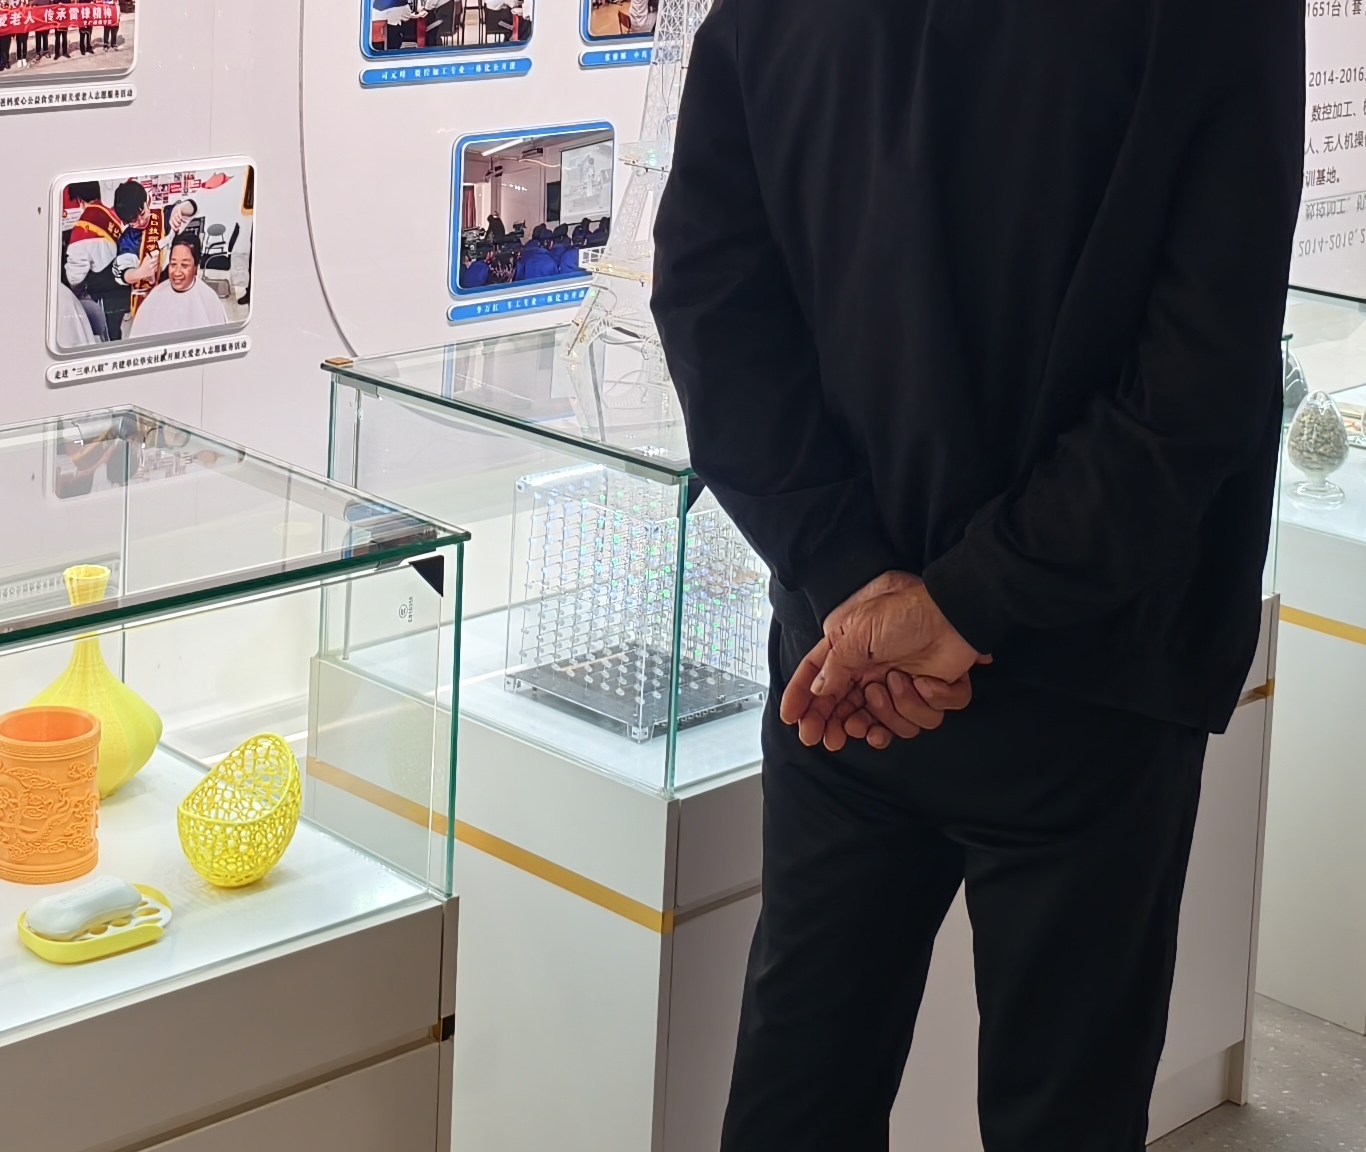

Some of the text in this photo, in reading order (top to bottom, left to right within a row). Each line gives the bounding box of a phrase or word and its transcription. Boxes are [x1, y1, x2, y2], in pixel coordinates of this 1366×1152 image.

[43, 6, 113, 23] 传承雷锋精神
